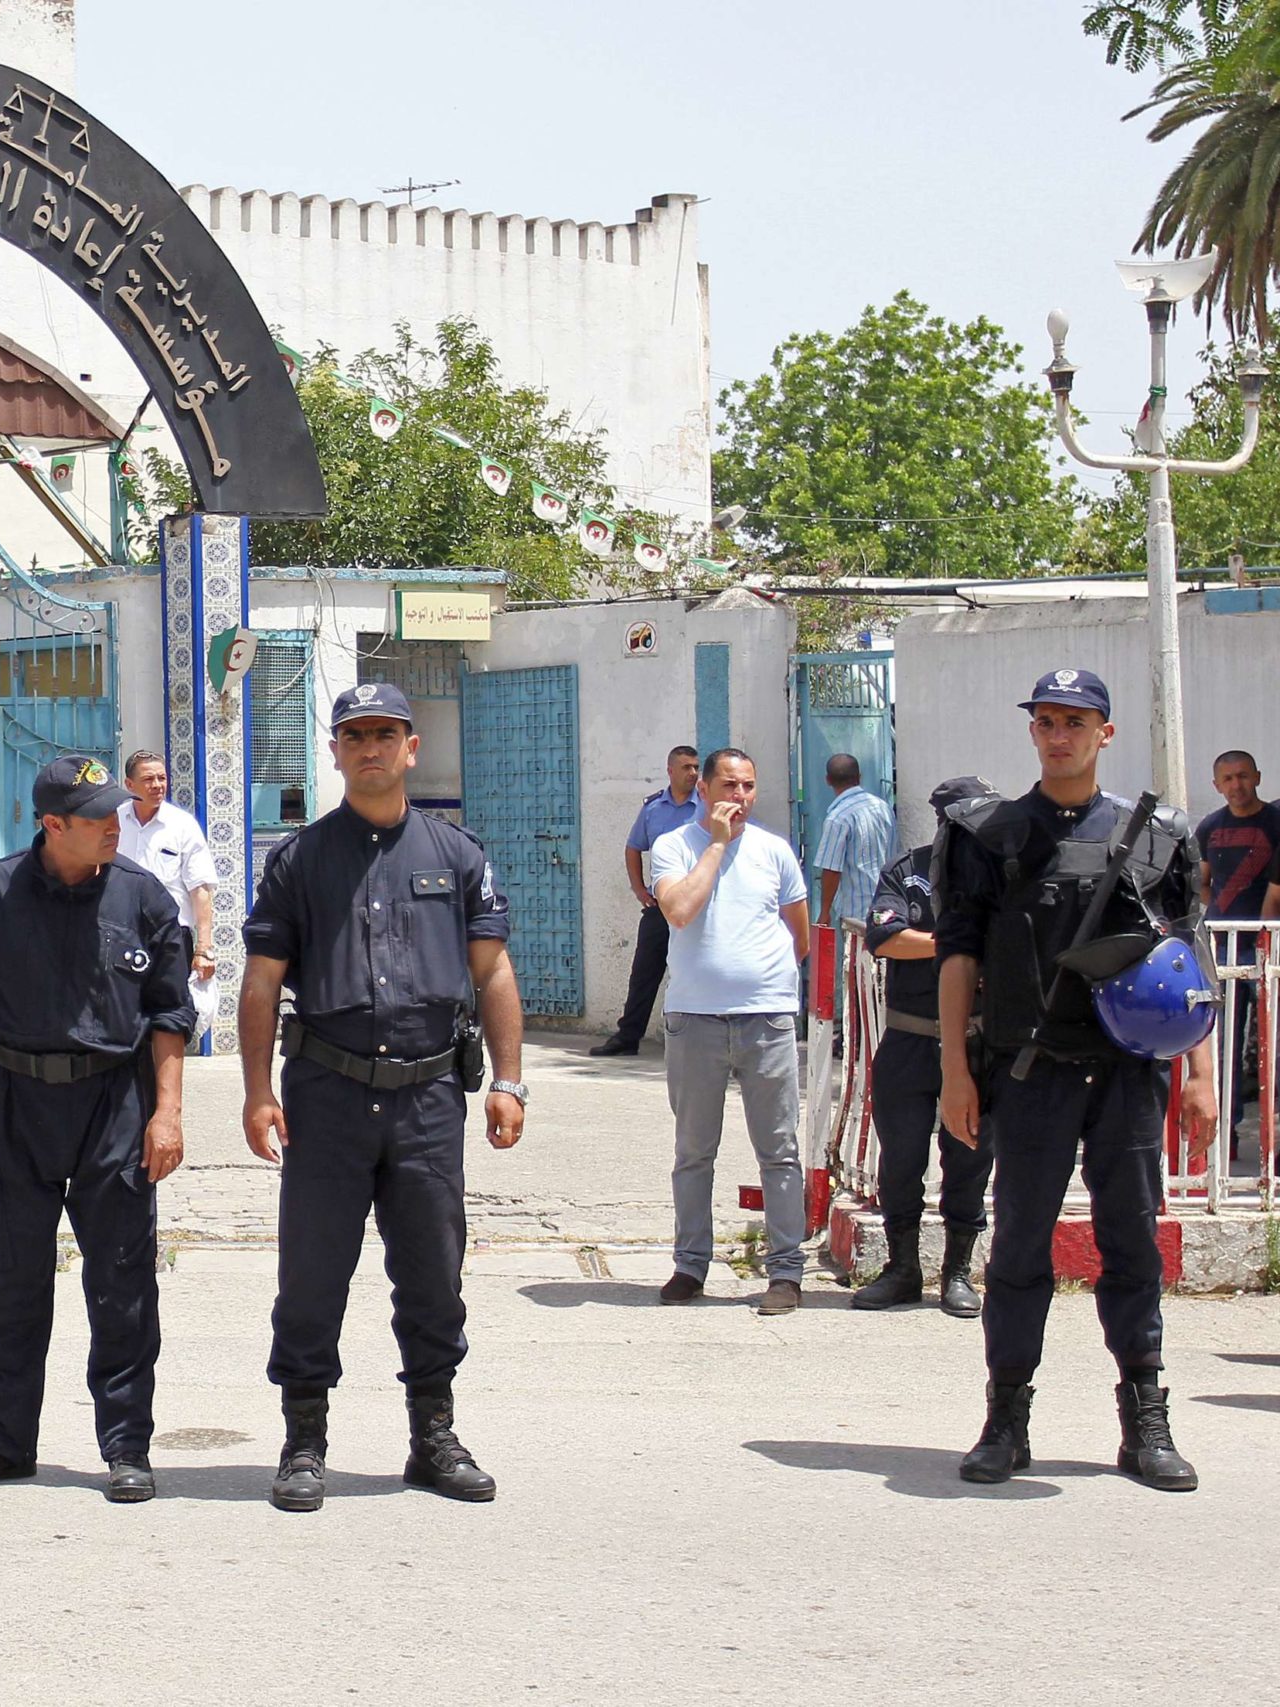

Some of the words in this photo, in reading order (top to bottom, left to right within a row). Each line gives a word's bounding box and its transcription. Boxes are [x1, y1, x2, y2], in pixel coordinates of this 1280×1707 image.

[34, 192, 125, 290] إعادة
[142, 231, 252, 391] المديرية
[116, 269, 232, 478] مؤسسة
